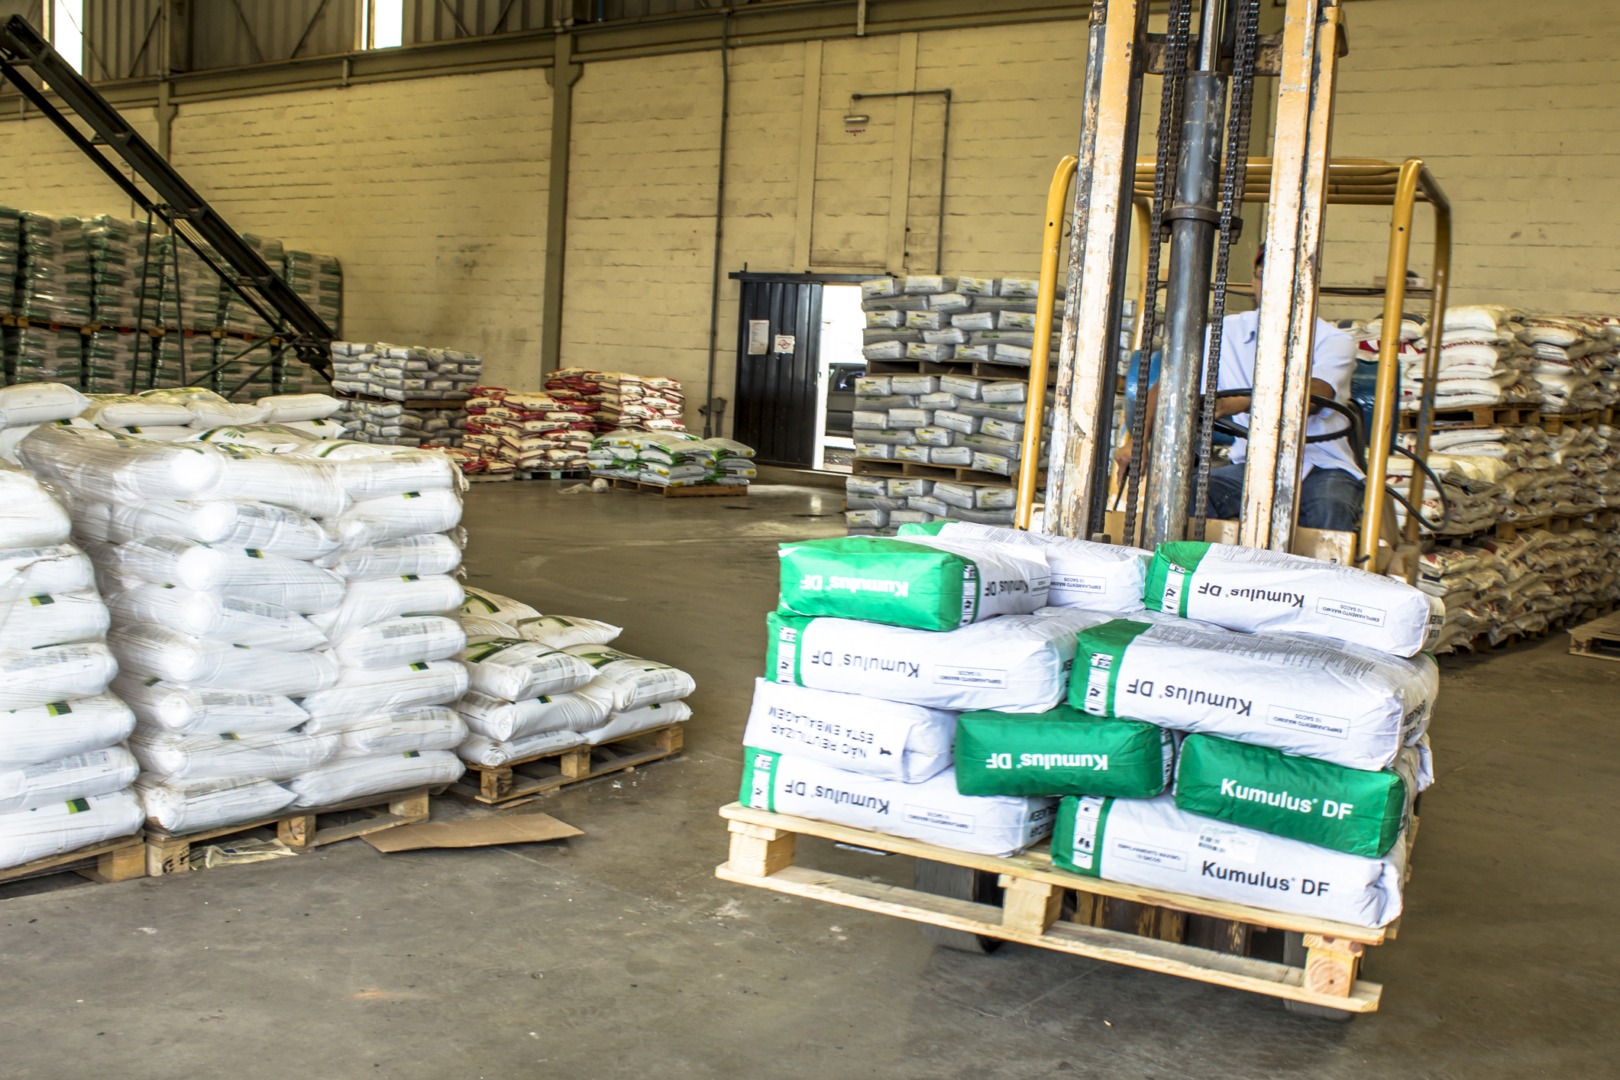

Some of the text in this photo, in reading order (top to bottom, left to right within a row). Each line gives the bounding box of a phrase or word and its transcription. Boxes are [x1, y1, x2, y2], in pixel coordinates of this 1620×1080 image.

[800, 574, 824, 590] DF
[984, 581, 997, 597] DF
[1198, 582, 1222, 597] DF
[811, 650, 832, 666] DF
[1126, 678, 1154, 697] DF
[846, 729, 874, 744] ESTA
[986, 753, 1012, 769] DF
[784, 780, 806, 797] DF
[1322, 800, 1353, 820] DF
[1301, 878, 1330, 897] DF
